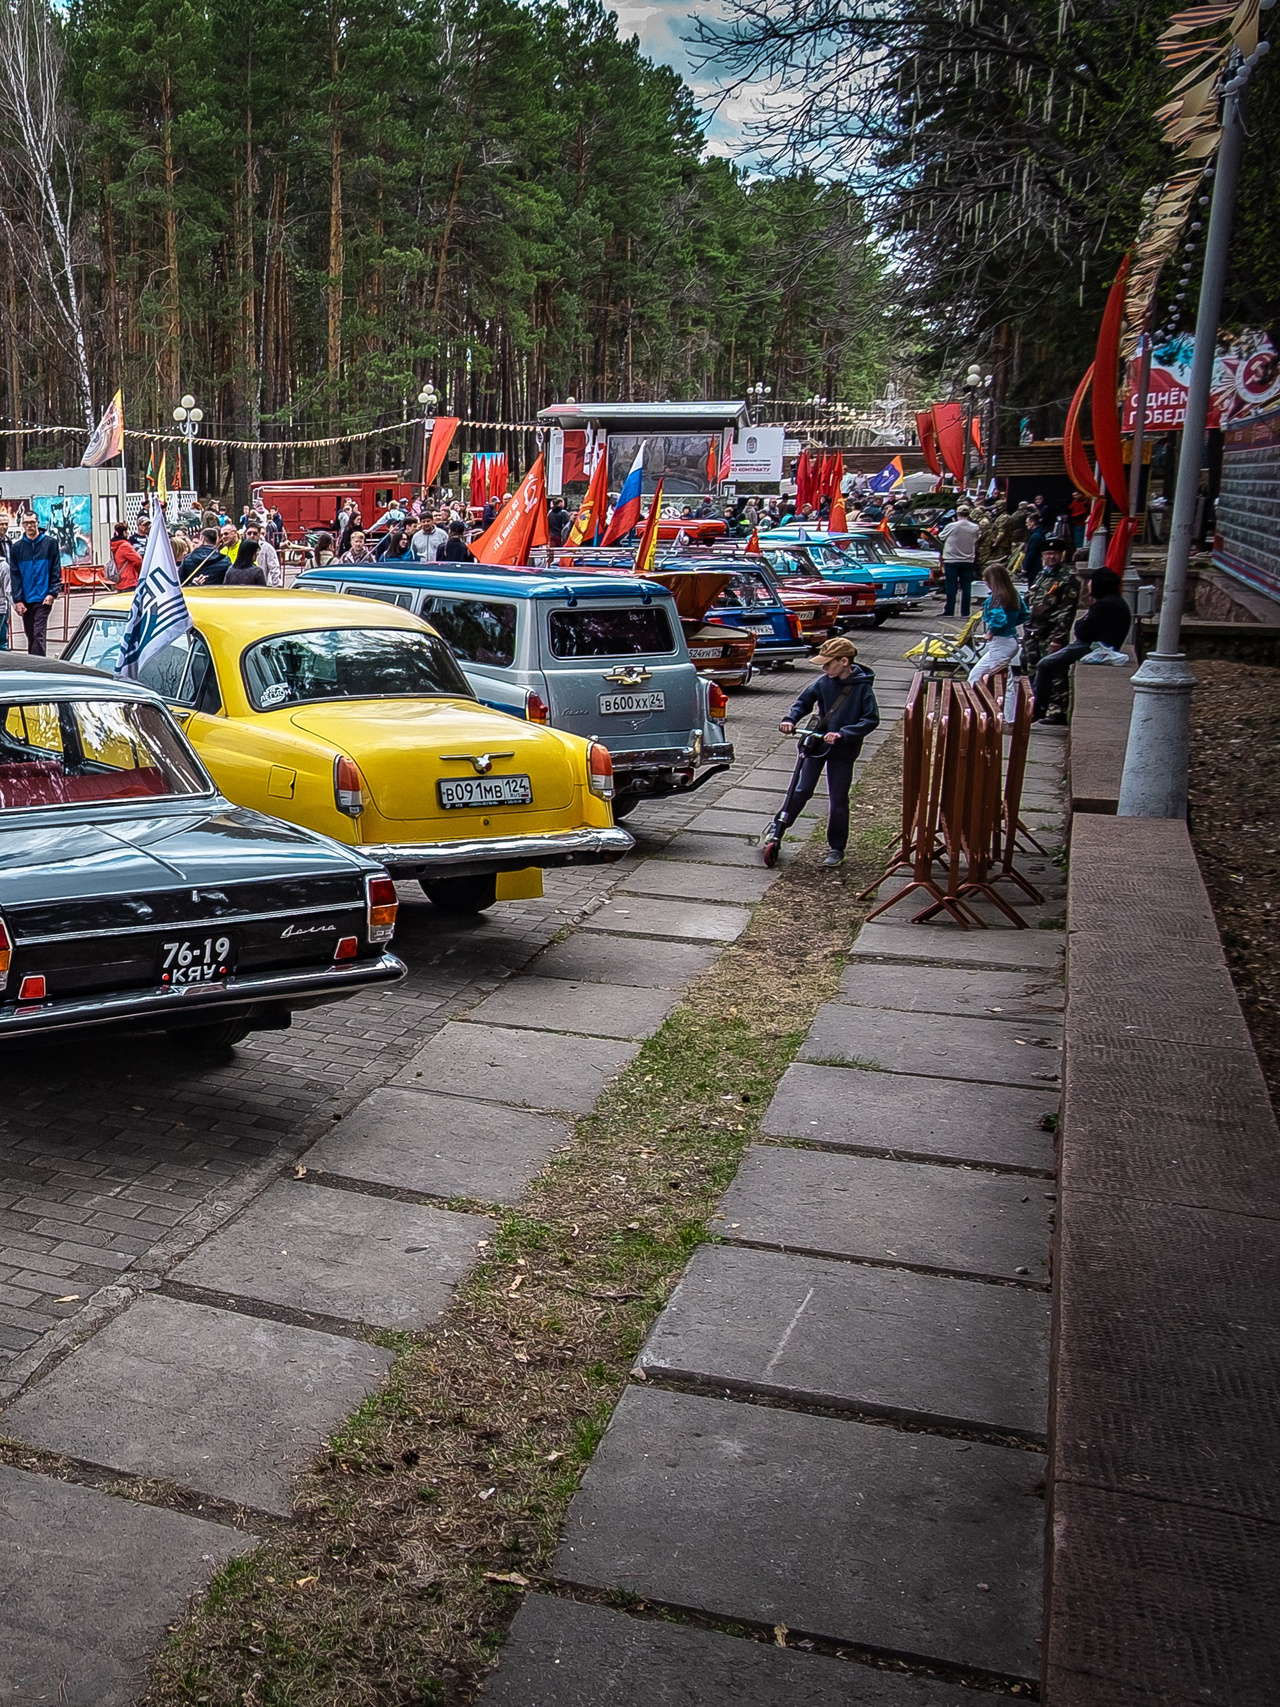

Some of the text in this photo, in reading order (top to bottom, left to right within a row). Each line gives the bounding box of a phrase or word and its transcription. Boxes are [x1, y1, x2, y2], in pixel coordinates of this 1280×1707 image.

[1129, 408, 1187, 426] ПОБЕД
[8, 530, 22, 540] ТЕАТР
[605, 693, 661, 711] В600ХХ 24
[446, 779, 526, 802] В091МВ 124
[162, 937, 230, 968] 76-19
[172, 963, 217, 984] КЯУ
